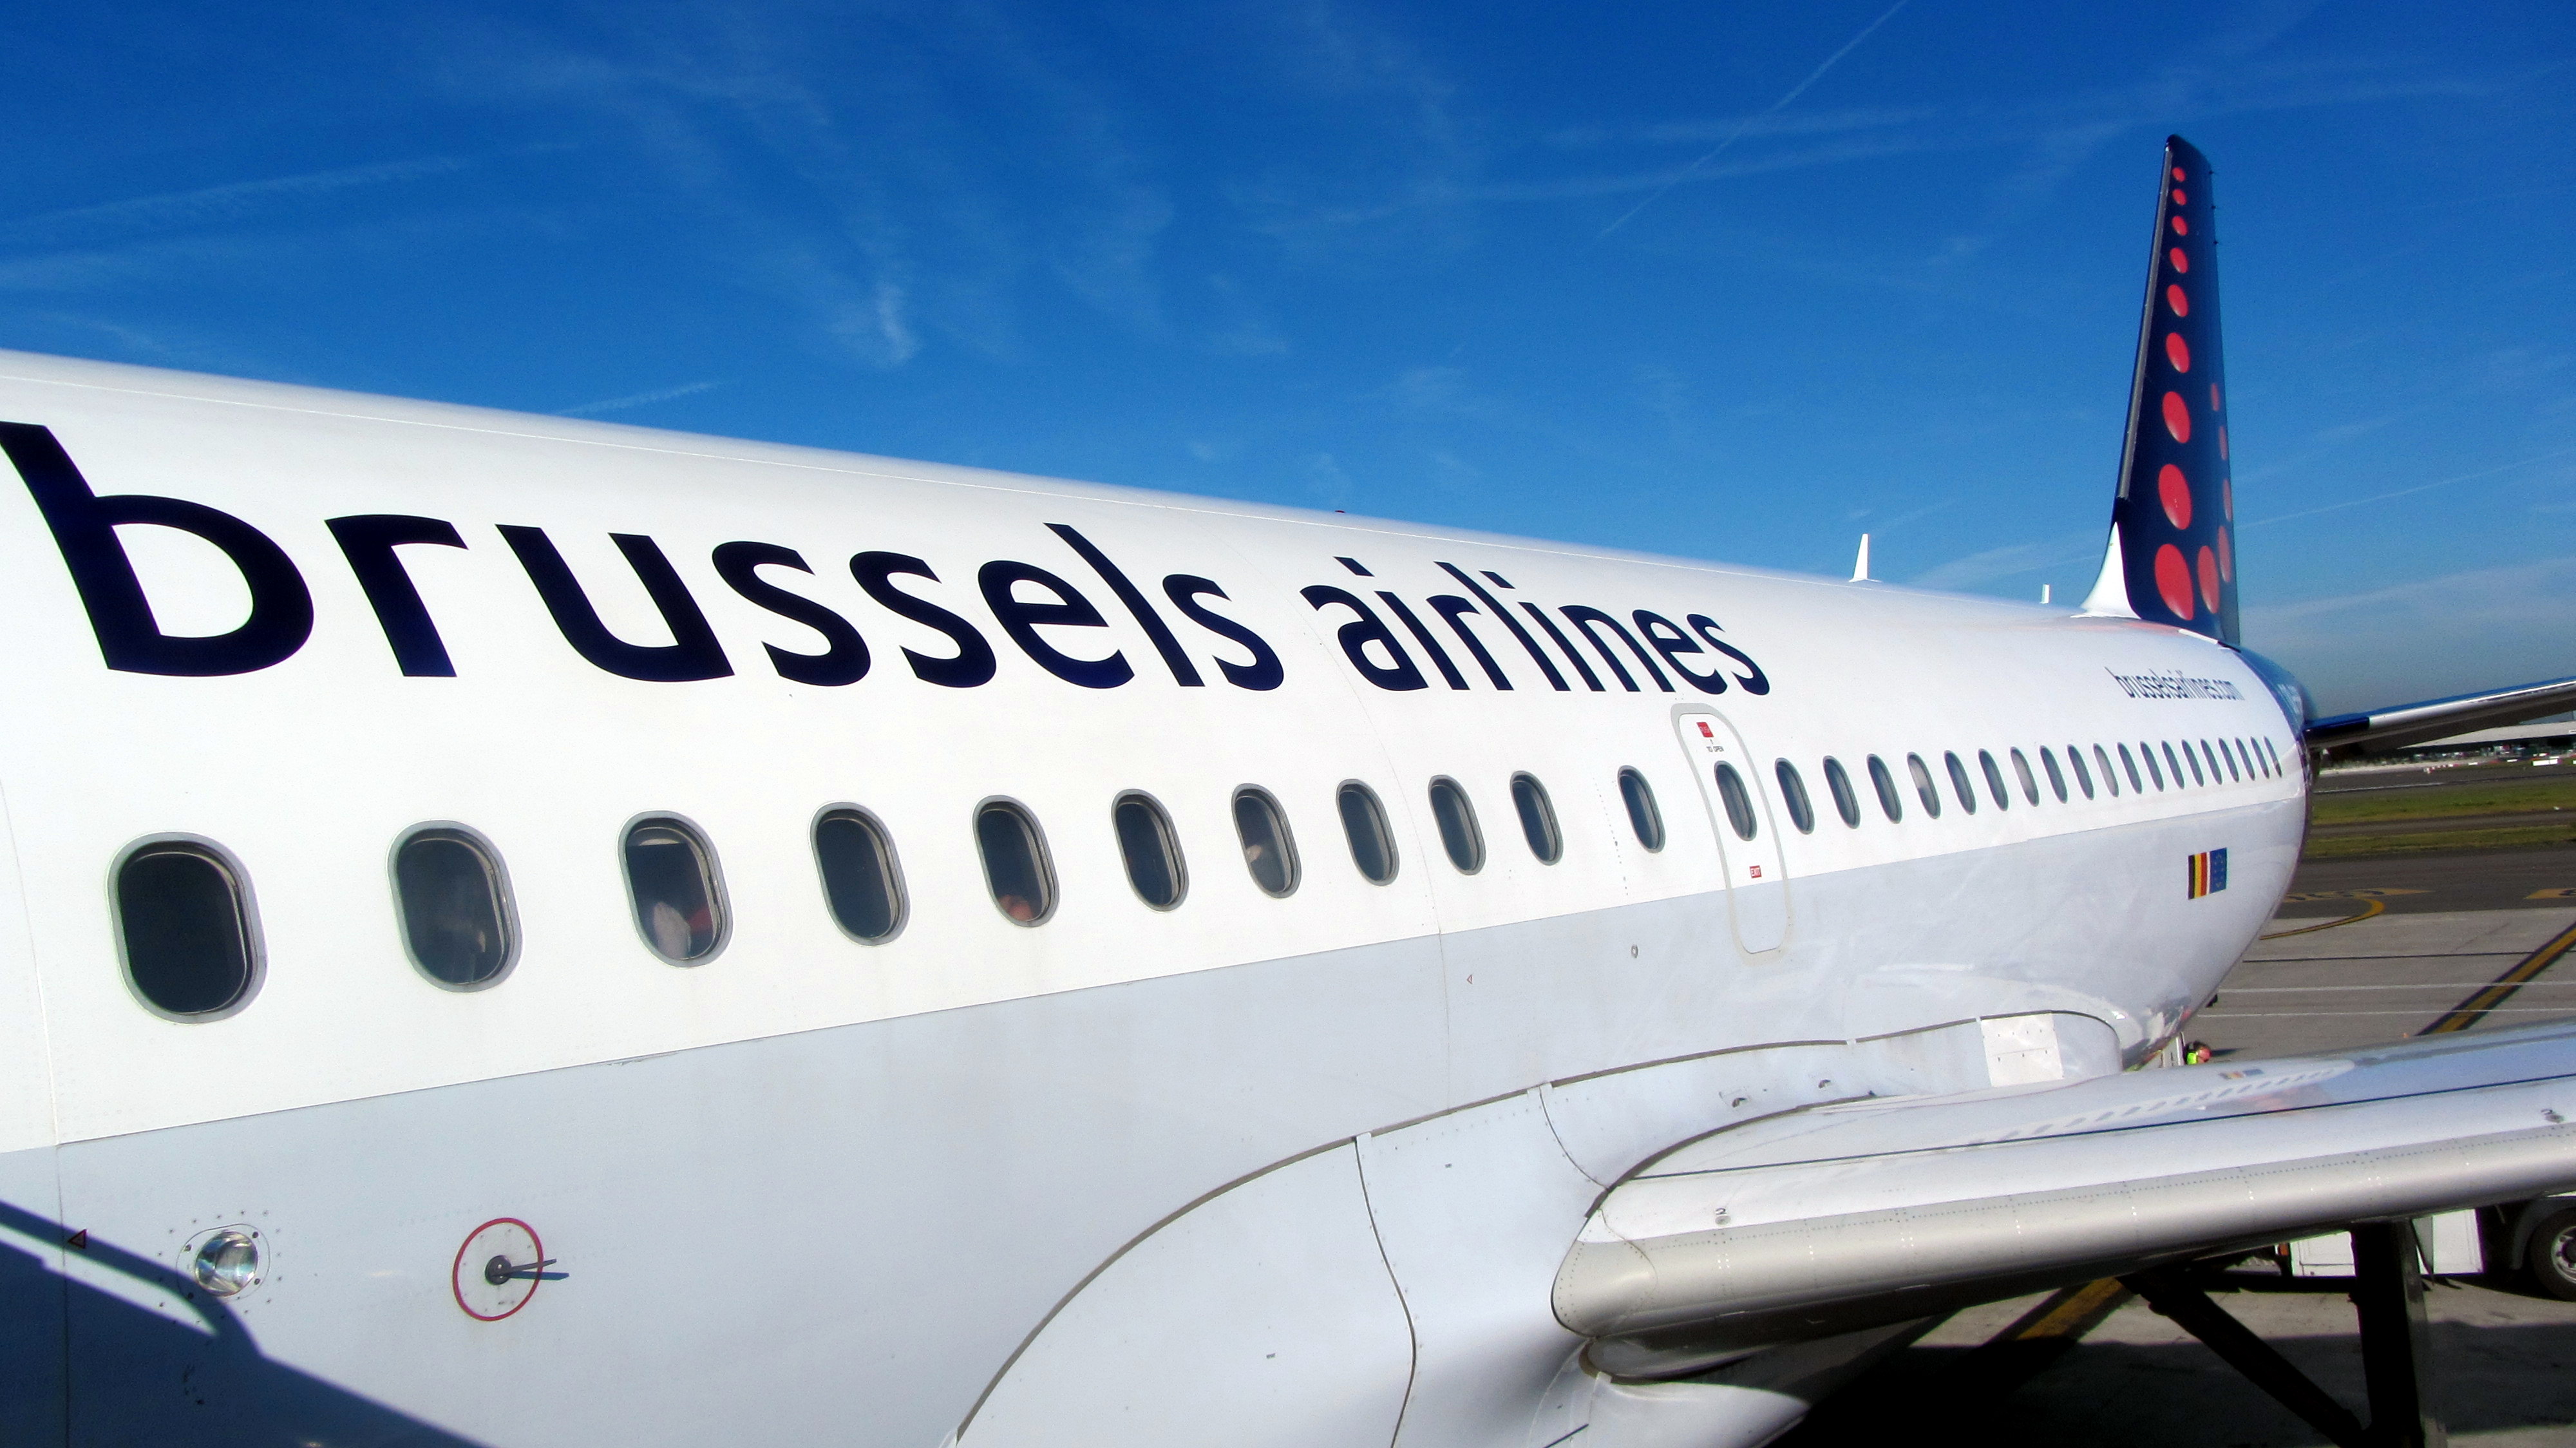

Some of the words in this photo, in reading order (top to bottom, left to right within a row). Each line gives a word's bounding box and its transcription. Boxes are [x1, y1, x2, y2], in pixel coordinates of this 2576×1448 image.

[0, 421, 1283, 691] brussels
[1300, 557, 1769, 695] airlines
[2104, 666, 2245, 700] brusselsairlines.com
[1750, 867, 1761, 877] EXIT
